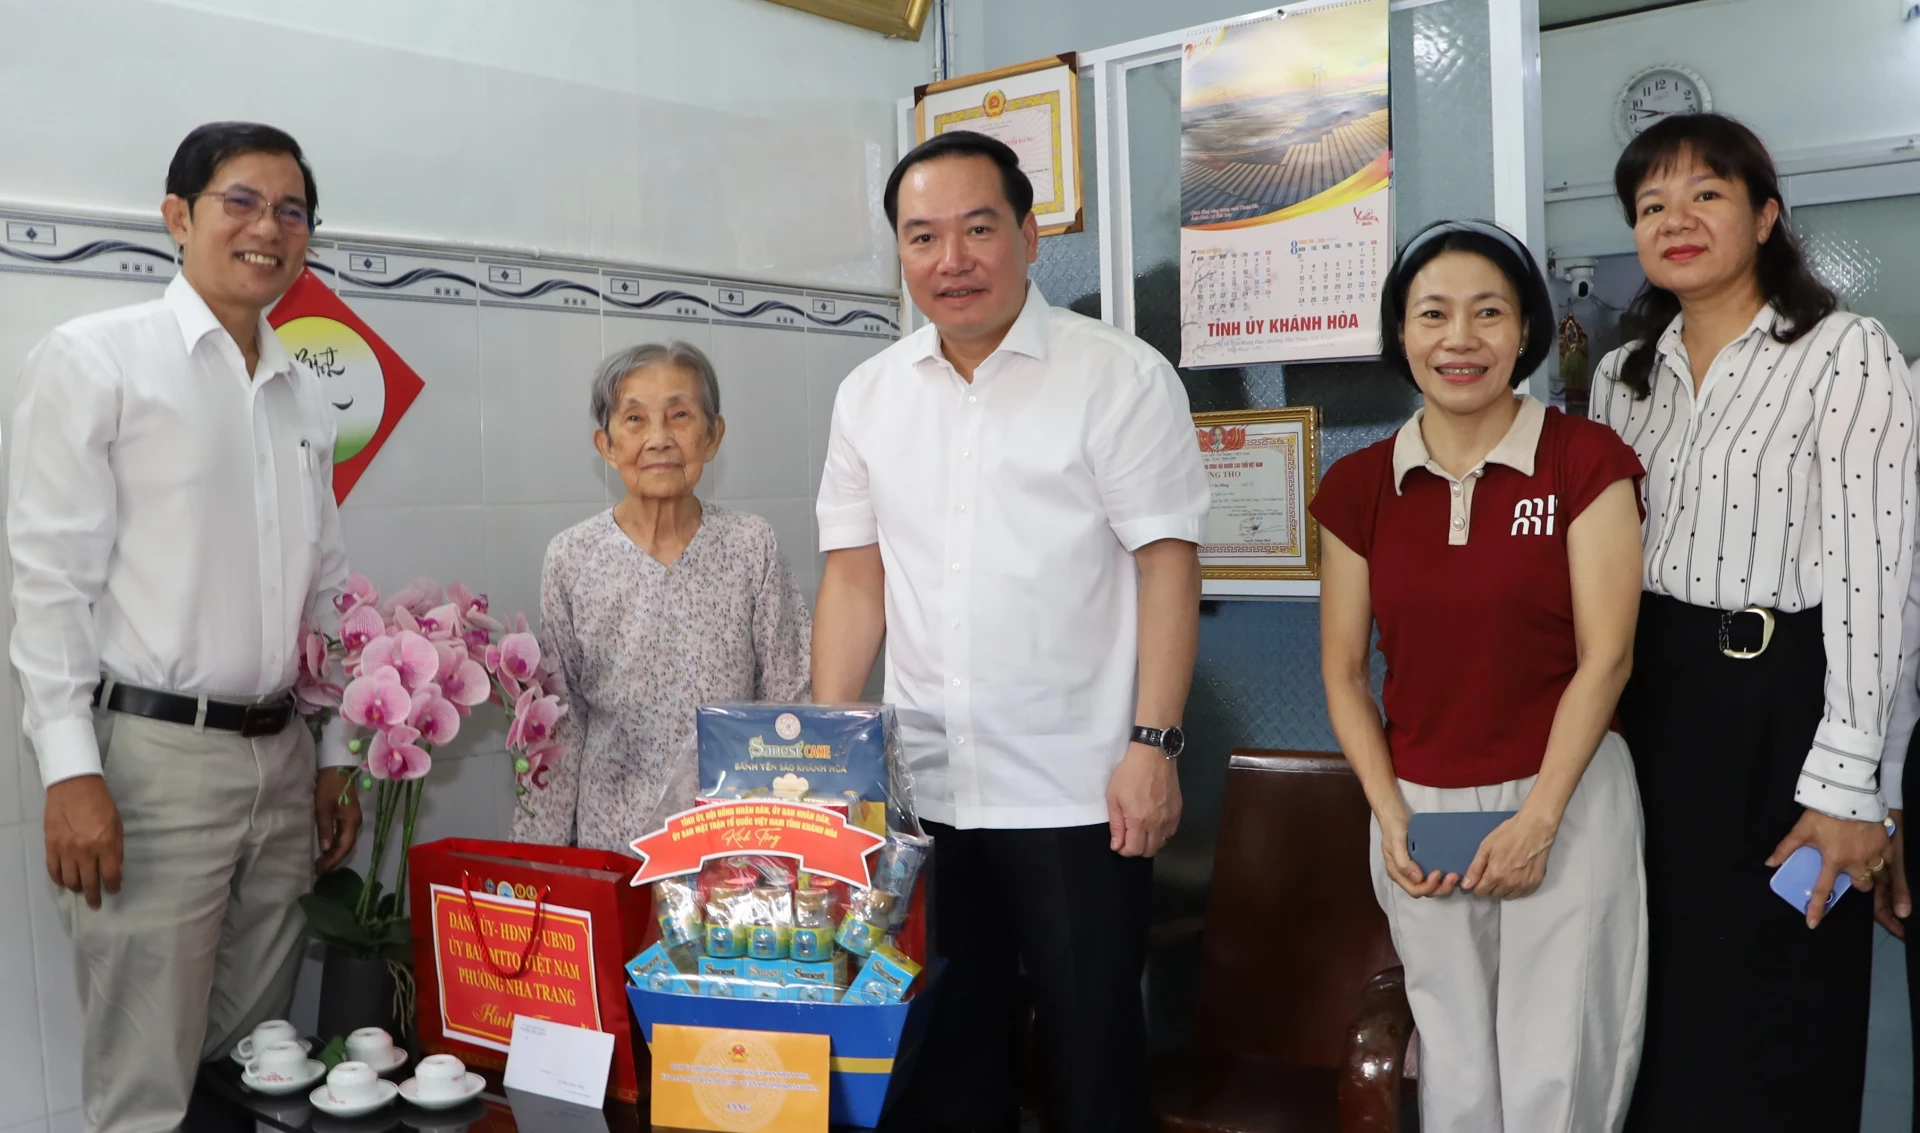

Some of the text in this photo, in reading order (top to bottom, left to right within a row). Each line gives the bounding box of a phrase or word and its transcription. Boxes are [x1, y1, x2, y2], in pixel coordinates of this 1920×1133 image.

[1643, 86, 1651, 96] 11
[1655, 80, 1666, 90] 12
[1675, 81, 1678, 91] 1
[1684, 90, 1691, 100] 2
[1633, 99, 1643, 109] 10
[1630, 114, 1637, 124] 9
[1291, 240, 1297, 255] 8
[1191, 250, 1196, 264] 7
[1208, 311, 1358, 337] TỈNH ỦY KHÁNH HÒA
[749, 735, 831, 760] Sanest CAKE
[735, 762, 758, 771] BÁNH
[760, 761, 777, 771] YẾN
[797, 763, 826, 772] KHÁNH
[782, 808, 795, 816] BAN
[681, 827, 694, 838] BAN
[769, 818, 785, 827] NAM
[542, 930, 576, 952] UBND
[448, 934, 463, 956] ỦY
[488, 947, 521, 972] MTTQ
[554, 959, 581, 981] NAM
[704, 963, 738, 977] Sanest
[458, 967, 576, 1006] PHƯỜNG NHA TRANG
